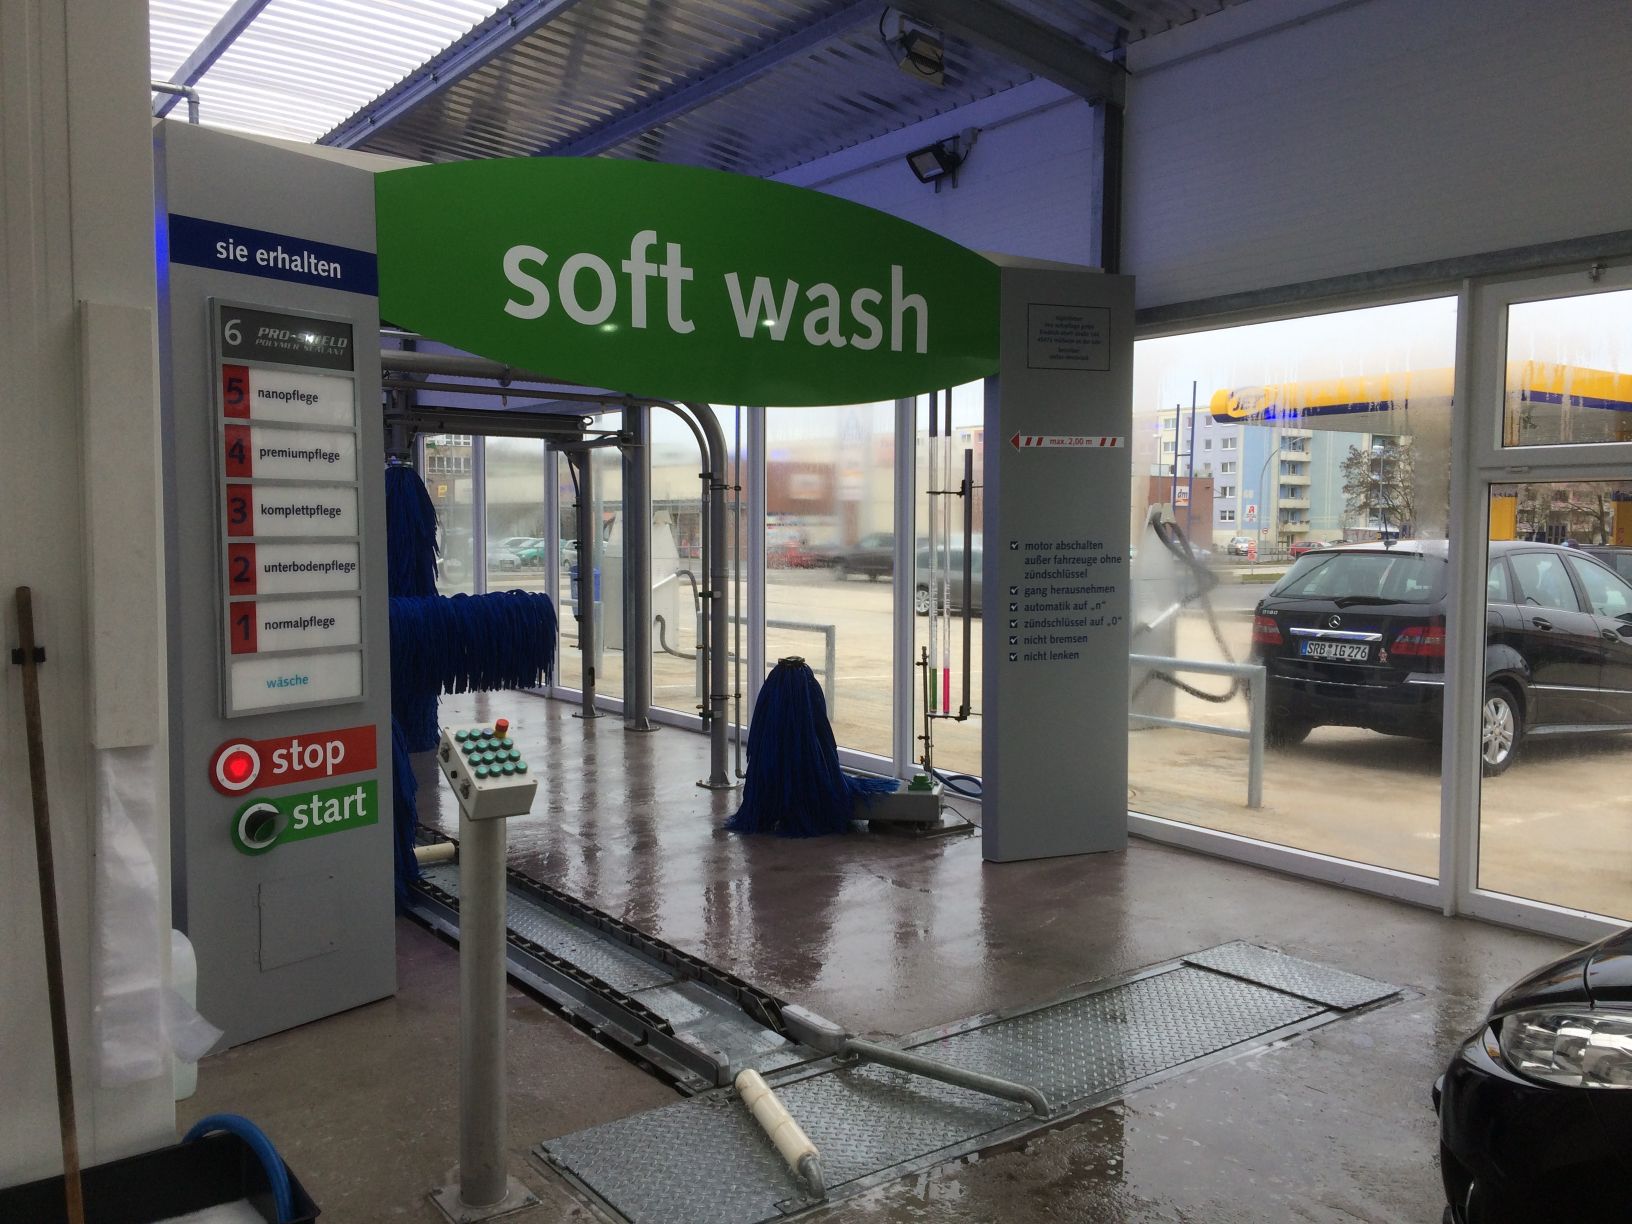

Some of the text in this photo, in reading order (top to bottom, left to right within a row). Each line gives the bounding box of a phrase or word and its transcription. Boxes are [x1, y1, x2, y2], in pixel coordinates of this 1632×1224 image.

[216, 238, 341, 279] sie erhalten
[503, 230, 929, 354] soft wash
[224, 319, 242, 345] 6
[226, 378, 244, 404] 5
[258, 388, 319, 405] nanopflege
[229, 438, 245, 465] 4
[259, 447, 340, 462] premiumpflege
[1177, 488, 1188, 498] dm
[231, 498, 247, 524] 3
[260, 504, 342, 517] komplettpflege
[1025, 540, 1103, 551] motor abschalten
[264, 561, 356, 574] unterbodenpflege
[1024, 554, 1122, 567] außer fahrzeuge ohne
[233, 556, 249, 583] 2
[1024, 568, 1088, 580] zündschlüssel
[1024, 584, 1115, 598] gang herausnehmen
[1024, 602, 1071, 612] automatik
[1073, 601, 1088, 611] auf
[237, 614, 250, 641] 1
[264, 616, 335, 632] normalpflege
[1024, 617, 1087, 629] zündschlüssel
[1090, 616, 1104, 626] auf
[1024, 634, 1088, 645] nicht bremsen
[1024, 650, 1080, 661] nicht lenken
[1307, 642, 1368, 659] SRB IG 276
[266, 675, 309, 689] wäsche
[272, 739, 345, 776] stop
[293, 786, 367, 829] start
